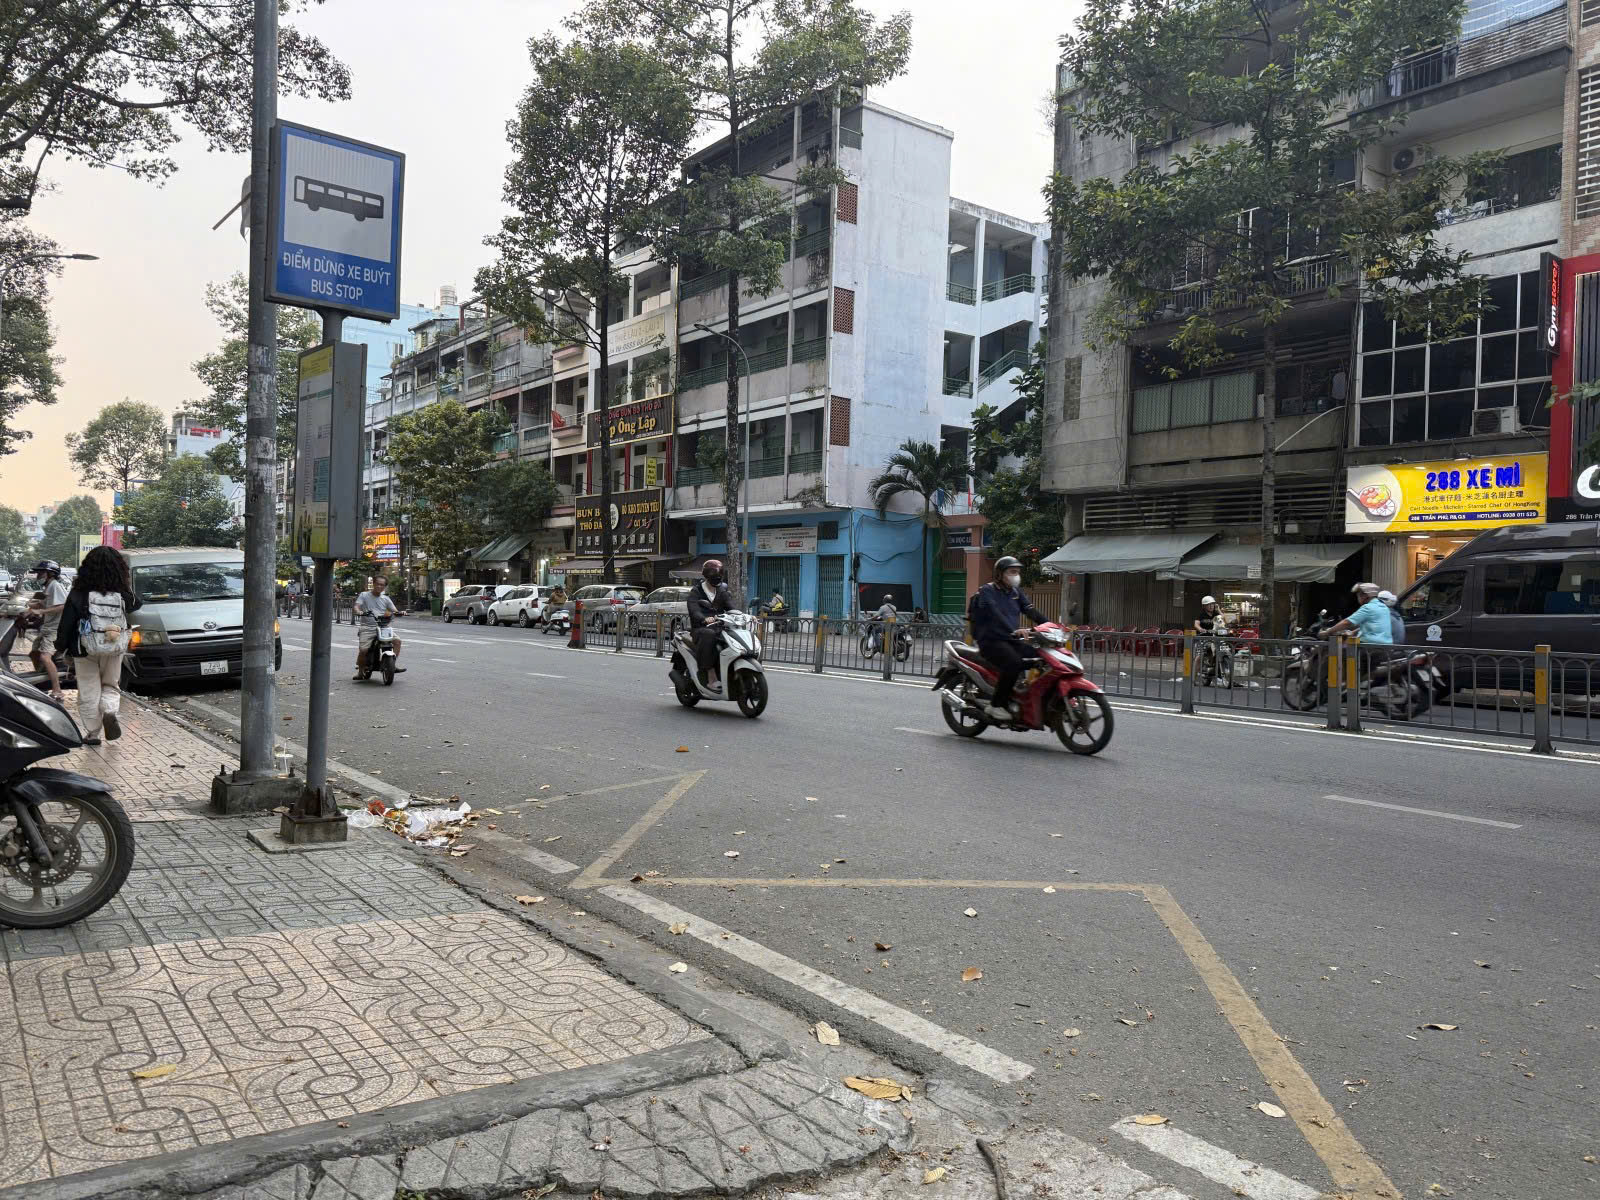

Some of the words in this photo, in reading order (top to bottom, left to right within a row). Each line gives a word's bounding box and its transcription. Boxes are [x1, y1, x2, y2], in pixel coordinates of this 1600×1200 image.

[283, 249, 311, 271] ĐIỂM
[314, 256, 345, 277] DỪNG
[347, 264, 362, 280] XE
[364, 267, 391, 286] BUÝT
[311, 279, 333, 296] BUS
[335, 283, 363, 301] STOP
[618, 417, 636, 435] Ông
[637, 414, 656, 432] Lập
[1425, 471, 1461, 492] 288
[1466, 467, 1492, 490] XE
[1495, 461, 1522, 488] MÌ
[594, 507, 601, 517] B
